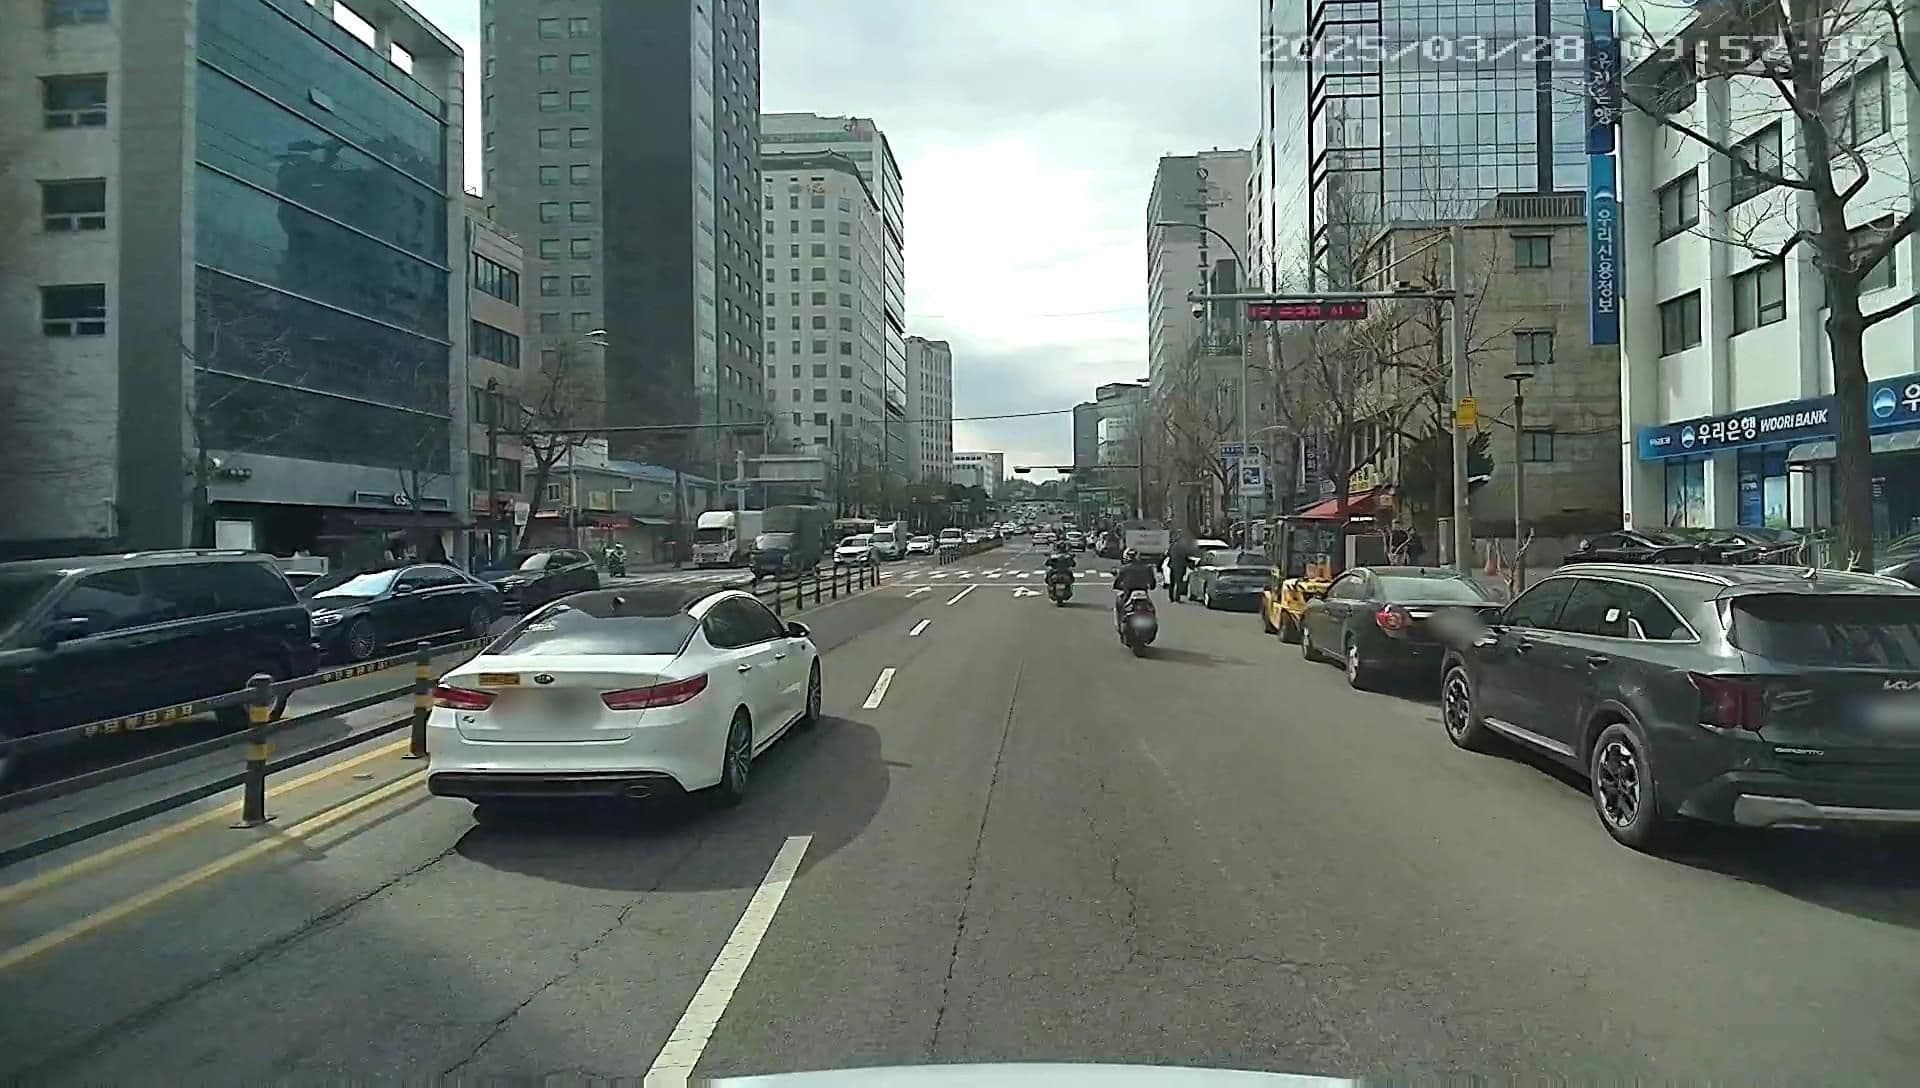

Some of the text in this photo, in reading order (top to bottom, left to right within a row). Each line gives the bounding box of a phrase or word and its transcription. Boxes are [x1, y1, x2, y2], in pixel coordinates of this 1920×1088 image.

[1597, 209, 1613, 312] 우리신용정보
[1698, 408, 1828, 445] 우리은행 WOORI BANK
